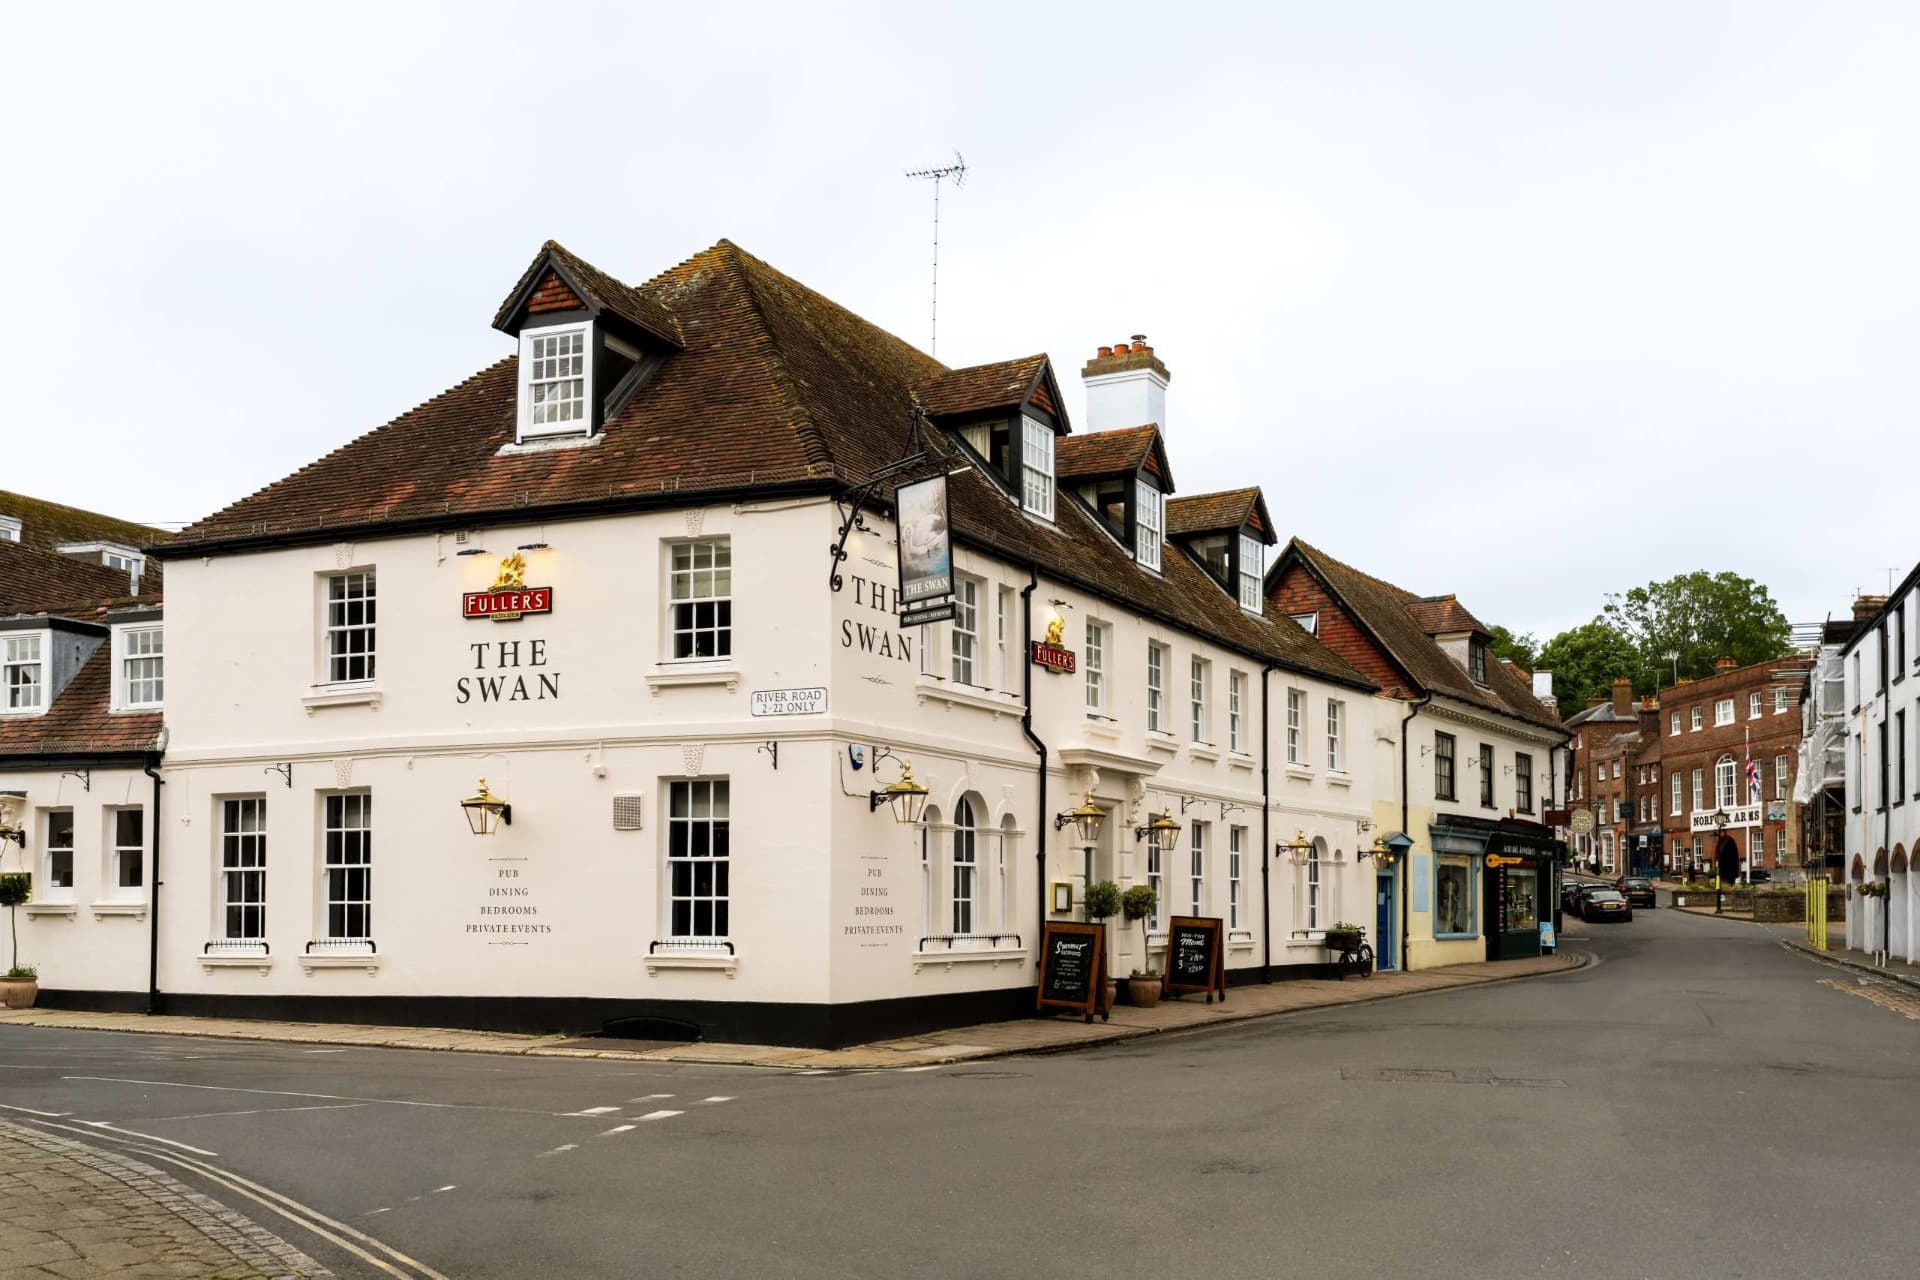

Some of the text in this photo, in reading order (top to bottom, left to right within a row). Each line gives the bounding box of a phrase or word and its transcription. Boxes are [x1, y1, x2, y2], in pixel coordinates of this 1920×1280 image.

[905, 576, 949, 596] THE SWAN
[851, 575, 900, 616] THE
[467, 592, 543, 612] FULLER'S
[841, 619, 912, 663] SWAN
[470, 639, 547, 669] THE
[1037, 645, 1073, 668] FULLER'S
[456, 672, 561, 704] SWAN
[756, 690, 822, 702] RIVER ROAD
[786, 702, 816, 712] ONLY
[1693, 810, 1760, 827] NORFK ARMS
[499, 869, 519, 878] PUB
[868, 868, 882, 877] PUB
[489, 887, 529, 896] DINING
[861, 887, 888, 896] DINING
[480, 906, 537, 915] BEDROOMS
[855, 906, 894, 915] BEDROOMS
[466, 924, 551, 933] PRIVATE EVENTS
[844, 925, 903, 935] PRIVATE EVENTS
